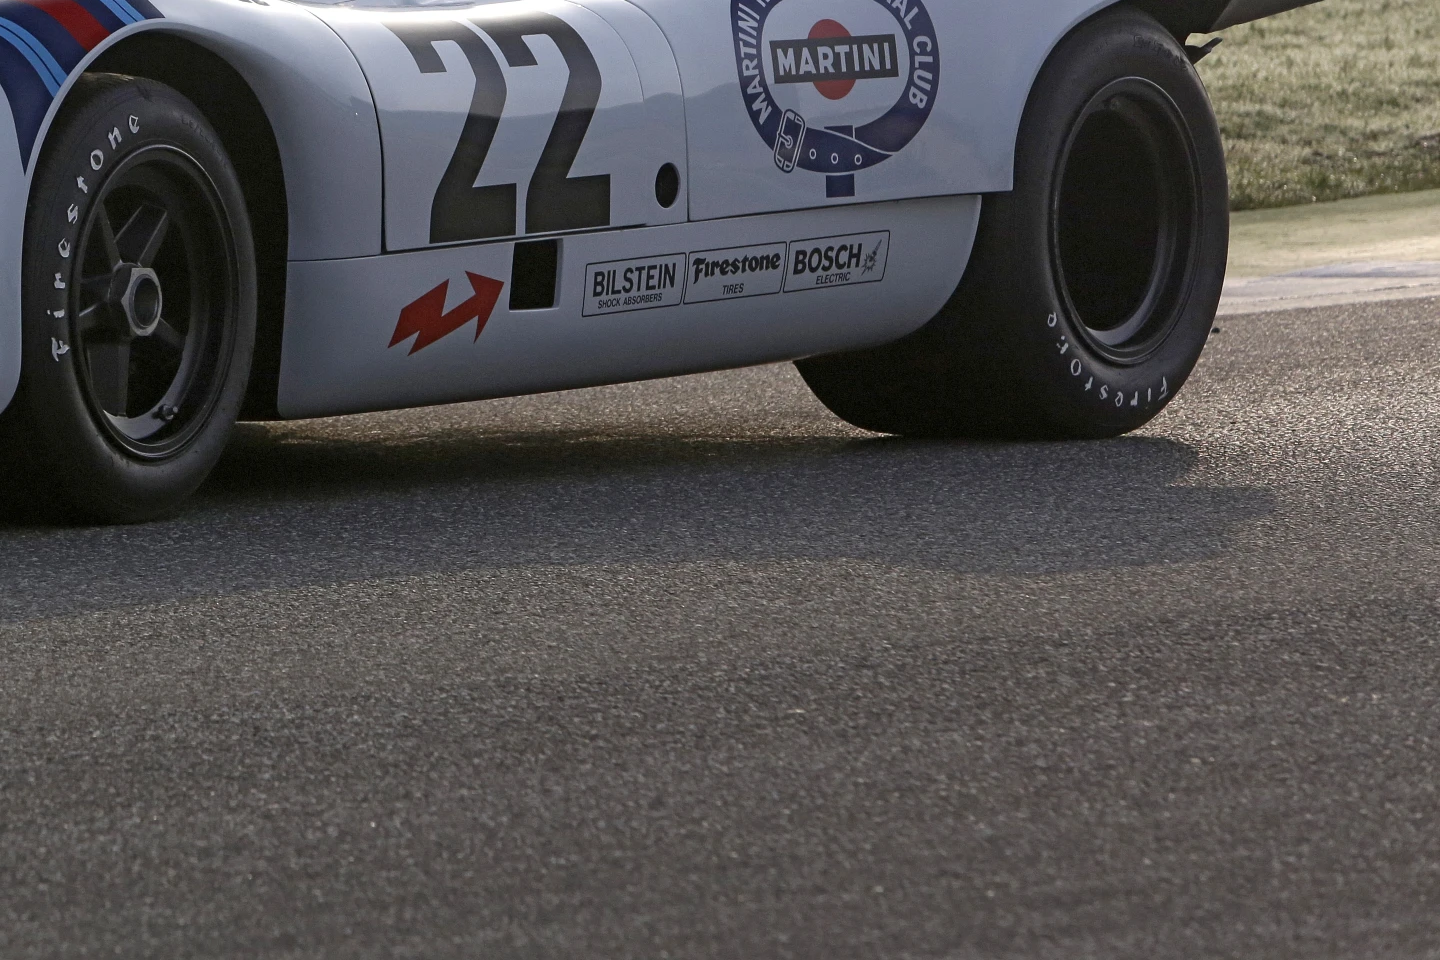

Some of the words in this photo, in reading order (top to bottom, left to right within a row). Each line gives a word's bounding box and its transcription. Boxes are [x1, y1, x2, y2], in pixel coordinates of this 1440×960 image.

[737, 2, 773, 125] MARTINI
[908, 35, 934, 110] CLUB
[776, 41, 892, 76] MARTINI
[380, 8, 611, 244] 22
[692, 252, 781, 285] Firestone
[792, 242, 863, 276] BOSCH
[592, 262, 677, 298] BILSTEIN
[722, 282, 745, 296] TIRES
[815, 271, 851, 286] ELECTRIC
[597, 297, 621, 310] SHOCK
[622, 292, 663, 307] ABSORBERS
